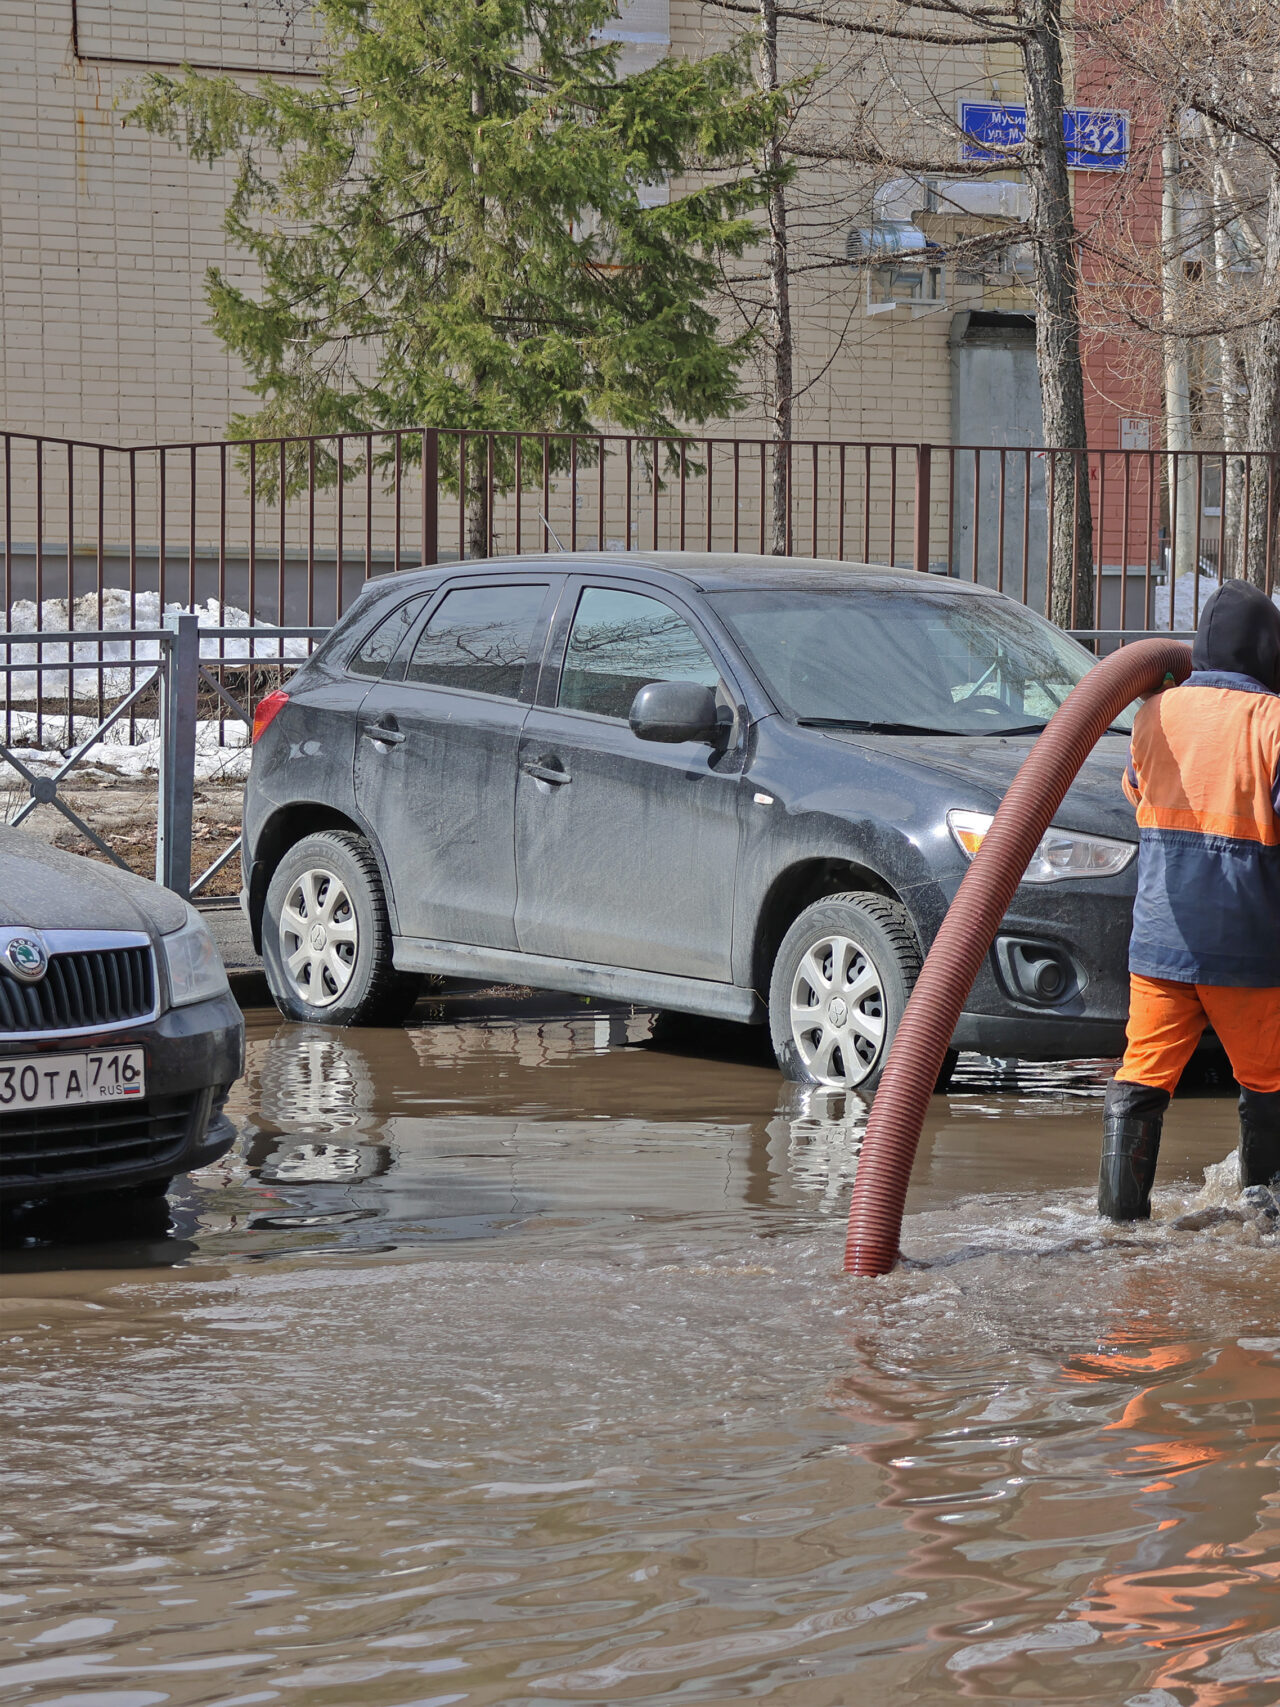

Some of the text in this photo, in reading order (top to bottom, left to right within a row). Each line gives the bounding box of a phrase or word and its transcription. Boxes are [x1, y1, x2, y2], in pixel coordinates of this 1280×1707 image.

[1083, 125, 1120, 153] 32
[90, 1054, 136, 1085] 716
[100, 1085, 122, 1096] RUS
